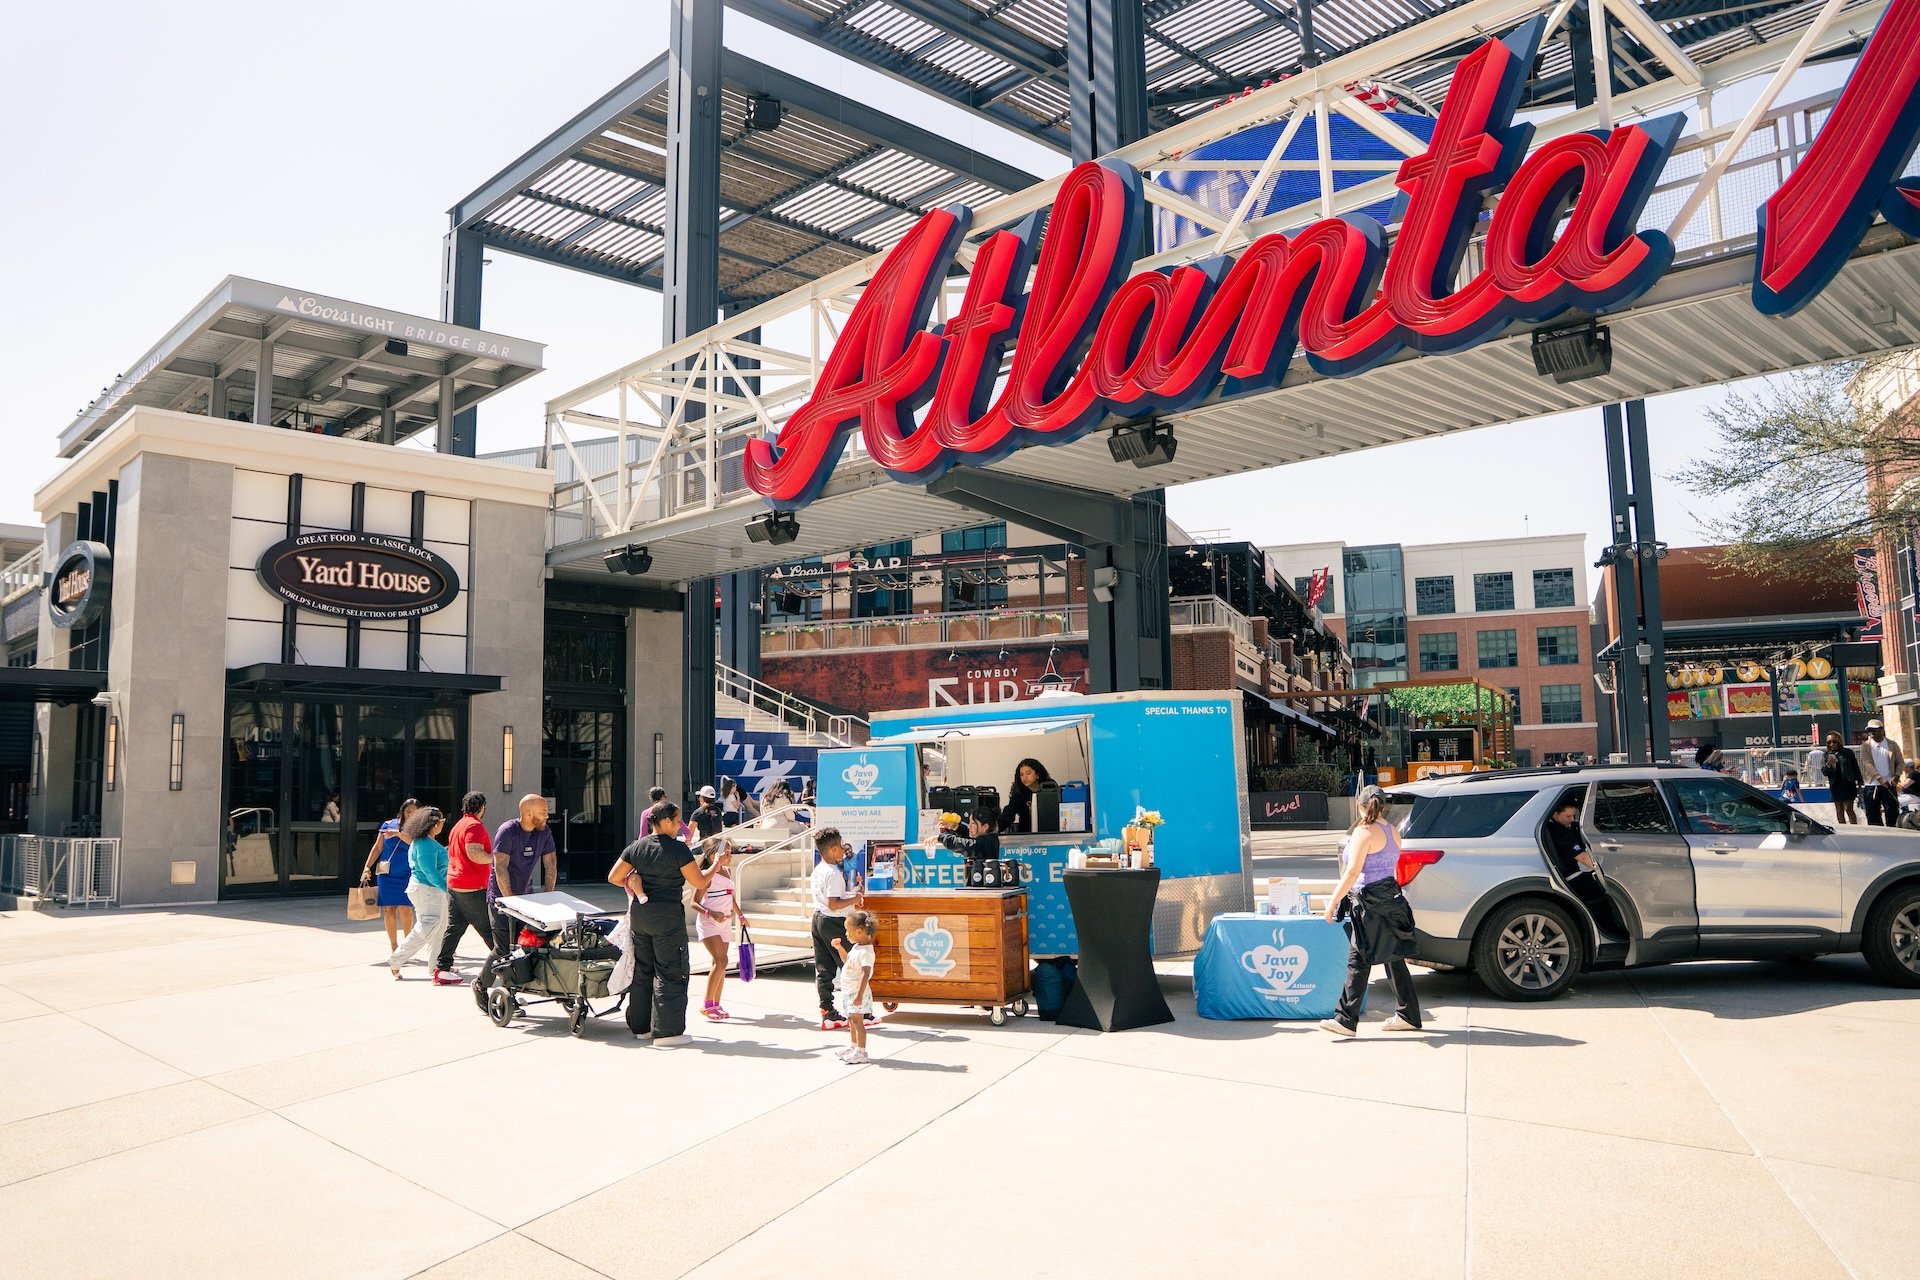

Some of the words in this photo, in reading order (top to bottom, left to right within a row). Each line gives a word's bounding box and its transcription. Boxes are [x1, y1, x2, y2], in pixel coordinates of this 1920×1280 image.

[744, 14, 1674, 510] Atlanta
[299, 297, 349, 322] Coors
[350, 314, 395, 333] LIGHT
[405, 326, 471, 349] BRIDGE
[477, 341, 511, 358] BAR
[296, 534, 328, 546] GREAT
[330, 534, 357, 543] FOOD
[369, 536, 408, 551] CLASSIC
[408, 545, 435, 562] ROCK
[296, 555, 354, 587] Yard
[357, 562, 432, 594] House
[790, 565, 826, 577] Coors
[279, 586, 312, 606] WORLD'S
[311, 601, 346, 615] LARGEST
[346, 608, 387, 618] SELECTION
[387, 610, 398, 618] OF
[398, 607, 421, 618] DRAFT
[421, 603, 440, 615] BEER
[967, 667, 1019, 680] COWBOY
[1029, 683, 1073, 694] PBR
[1145, 707, 1180, 716] SPECIAL
[1181, 706, 1215, 715] THANKS
[1216, 706, 1228, 714] TO
[1745, 736, 1771, 746] BOX
[854, 769, 873, 777] Java
[855, 779, 870, 788] Joy
[1265, 794, 1300, 818] Live!
[1004, 846, 1048, 857] javajoy.org
[920, 938, 944, 947] Java
[924, 948, 941, 960] Joy
[1262, 954, 1299, 966] Java
[1267, 968, 1293, 983] Joy
